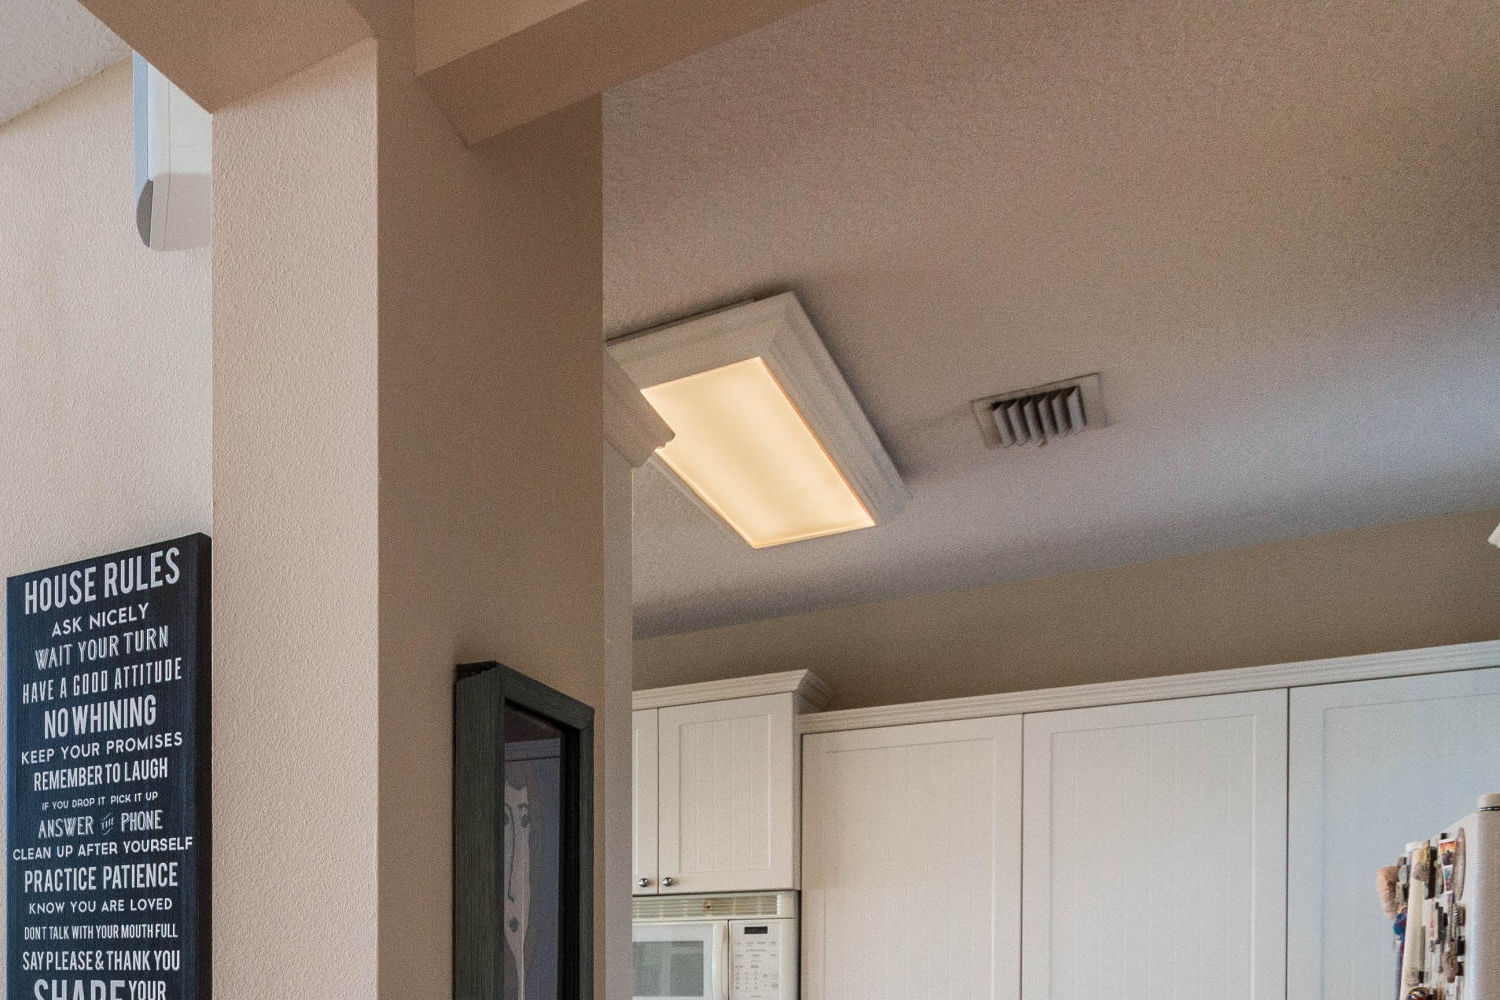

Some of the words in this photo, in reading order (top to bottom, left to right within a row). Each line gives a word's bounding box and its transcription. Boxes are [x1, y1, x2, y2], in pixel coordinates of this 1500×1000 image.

[25, 567, 96, 615] HOUSE
[105, 548, 179, 598] RULES
[52, 617, 82, 637] ASK
[90, 603, 149, 629] NICELY
[36, 644, 72, 670] WAIT
[78, 635, 119, 662] YOUR
[124, 626, 168, 654] TURN
[23, 680, 54, 704] HAVE
[60, 678, 67, 698] A
[74, 670, 107, 695] GOOD
[115, 658, 181, 689] ATTITUDE
[45, 709, 68, 739] NO
[72, 695, 156, 735] WHINING
[22, 748, 54, 764] KEEP
[61, 743, 99, 759] YOUR
[107, 732, 182, 754] PROMISES
[34, 767, 102, 791] REMEMBER
[105, 763, 120, 783] TO
[125, 758, 167, 781] LAUGH
[43, 801, 49, 810] IF
[53, 800, 68, 809] YOU
[72, 798, 95, 808] DROP
[98, 797, 105, 805] IT
[111, 794, 131, 804] PICK
[134, 793, 142, 801] IT
[146, 792, 158, 801] UP
[38, 816, 93, 838] ANSWER
[122, 810, 162, 832] PHONE
[13, 847, 50, 860] CLEAN
[57, 846, 72, 857] UP
[78, 842, 117, 856] AFTER
[123, 837, 192, 853] YOURSELF
[25, 867, 96, 893] PRACTICE
[104, 862, 178, 889] PATIENCE
[29, 902, 64, 914] KNOW
[70, 901, 96, 912] YOU
[102, 901, 124, 911] ARE
[131, 898, 172, 911] LOVED
[50, 926, 69, 939] TALK
[72, 926, 93, 939] WITH
[96, 925, 119, 939] YOUR
[121, 924, 153, 938] MOUTH
[156, 924, 178, 937] FULL
[23, 952, 44, 970] SAY
[47, 951, 92, 970] PLEASE
[95, 951, 104, 970] &
[107, 951, 149, 970] THANK
[154, 950, 180, 970] YOU
